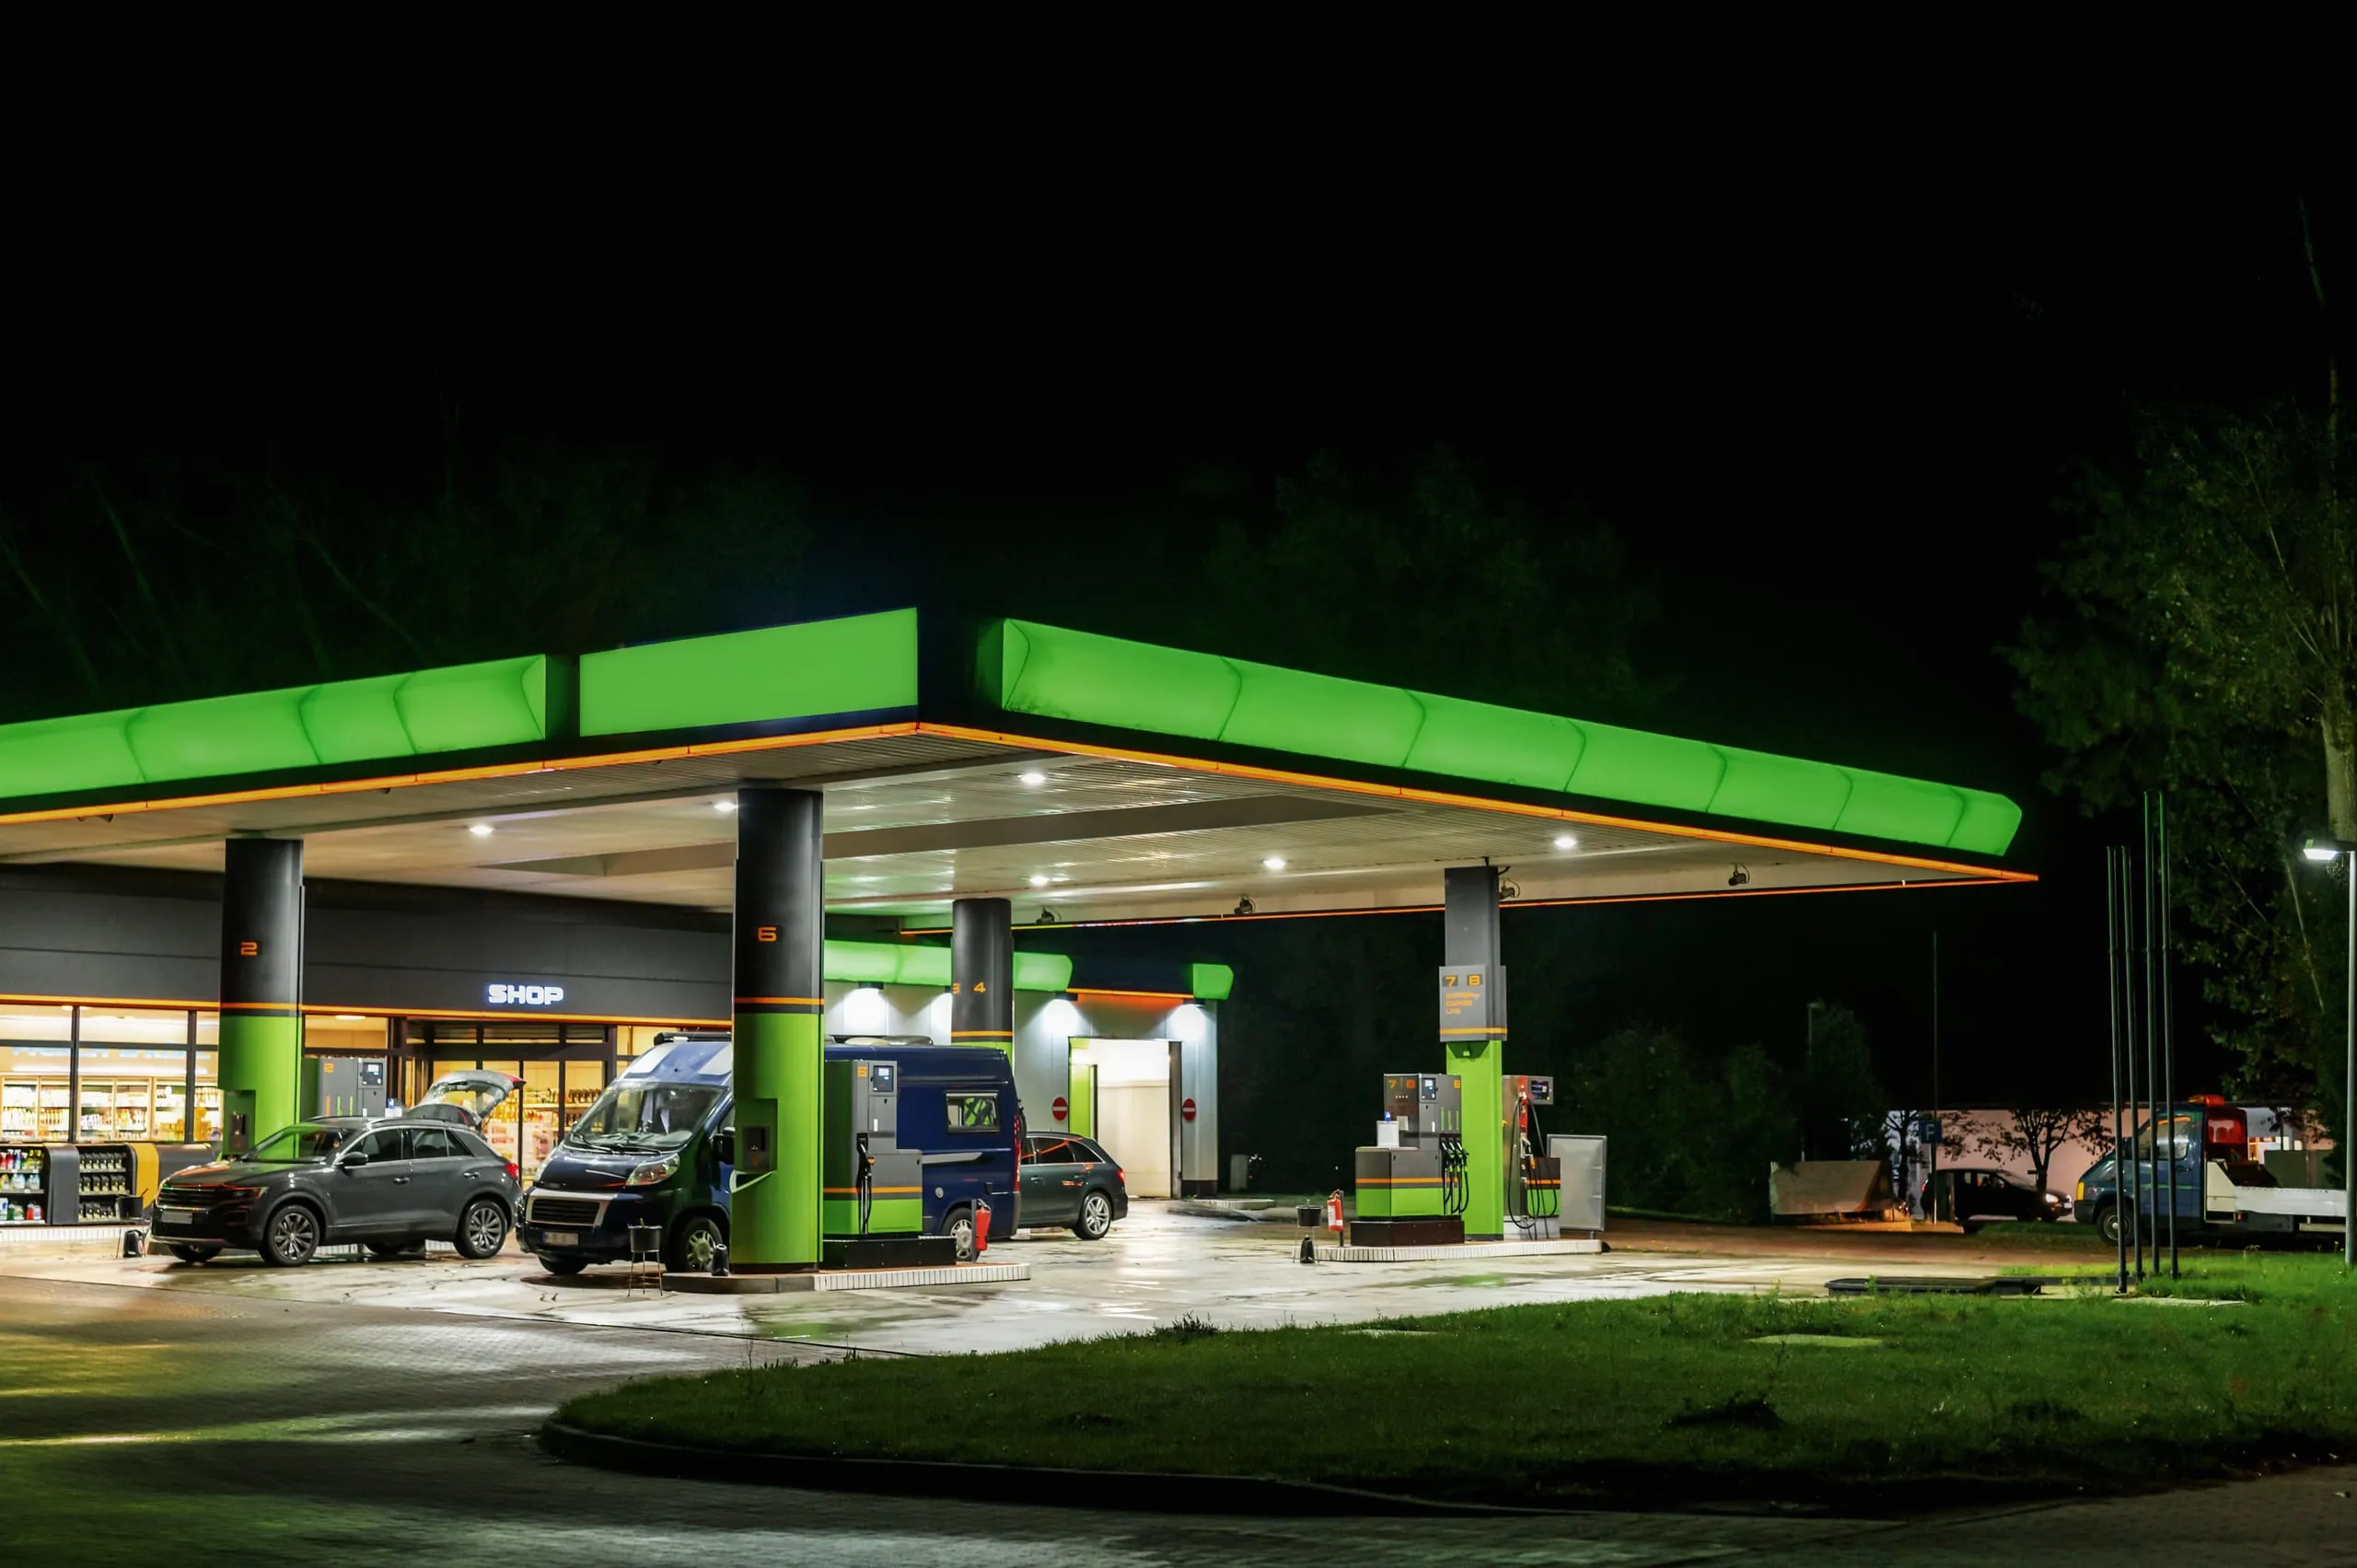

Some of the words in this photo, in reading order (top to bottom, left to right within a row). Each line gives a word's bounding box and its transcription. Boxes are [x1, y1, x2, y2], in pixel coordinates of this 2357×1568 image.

[758, 926, 777, 942] 6
[240, 942, 258, 956] 2
[973, 981, 987, 993] 4
[1445, 976, 1457, 987] 7
[1468, 974, 1481, 986] 8
[488, 983, 564, 1005] SHOP
